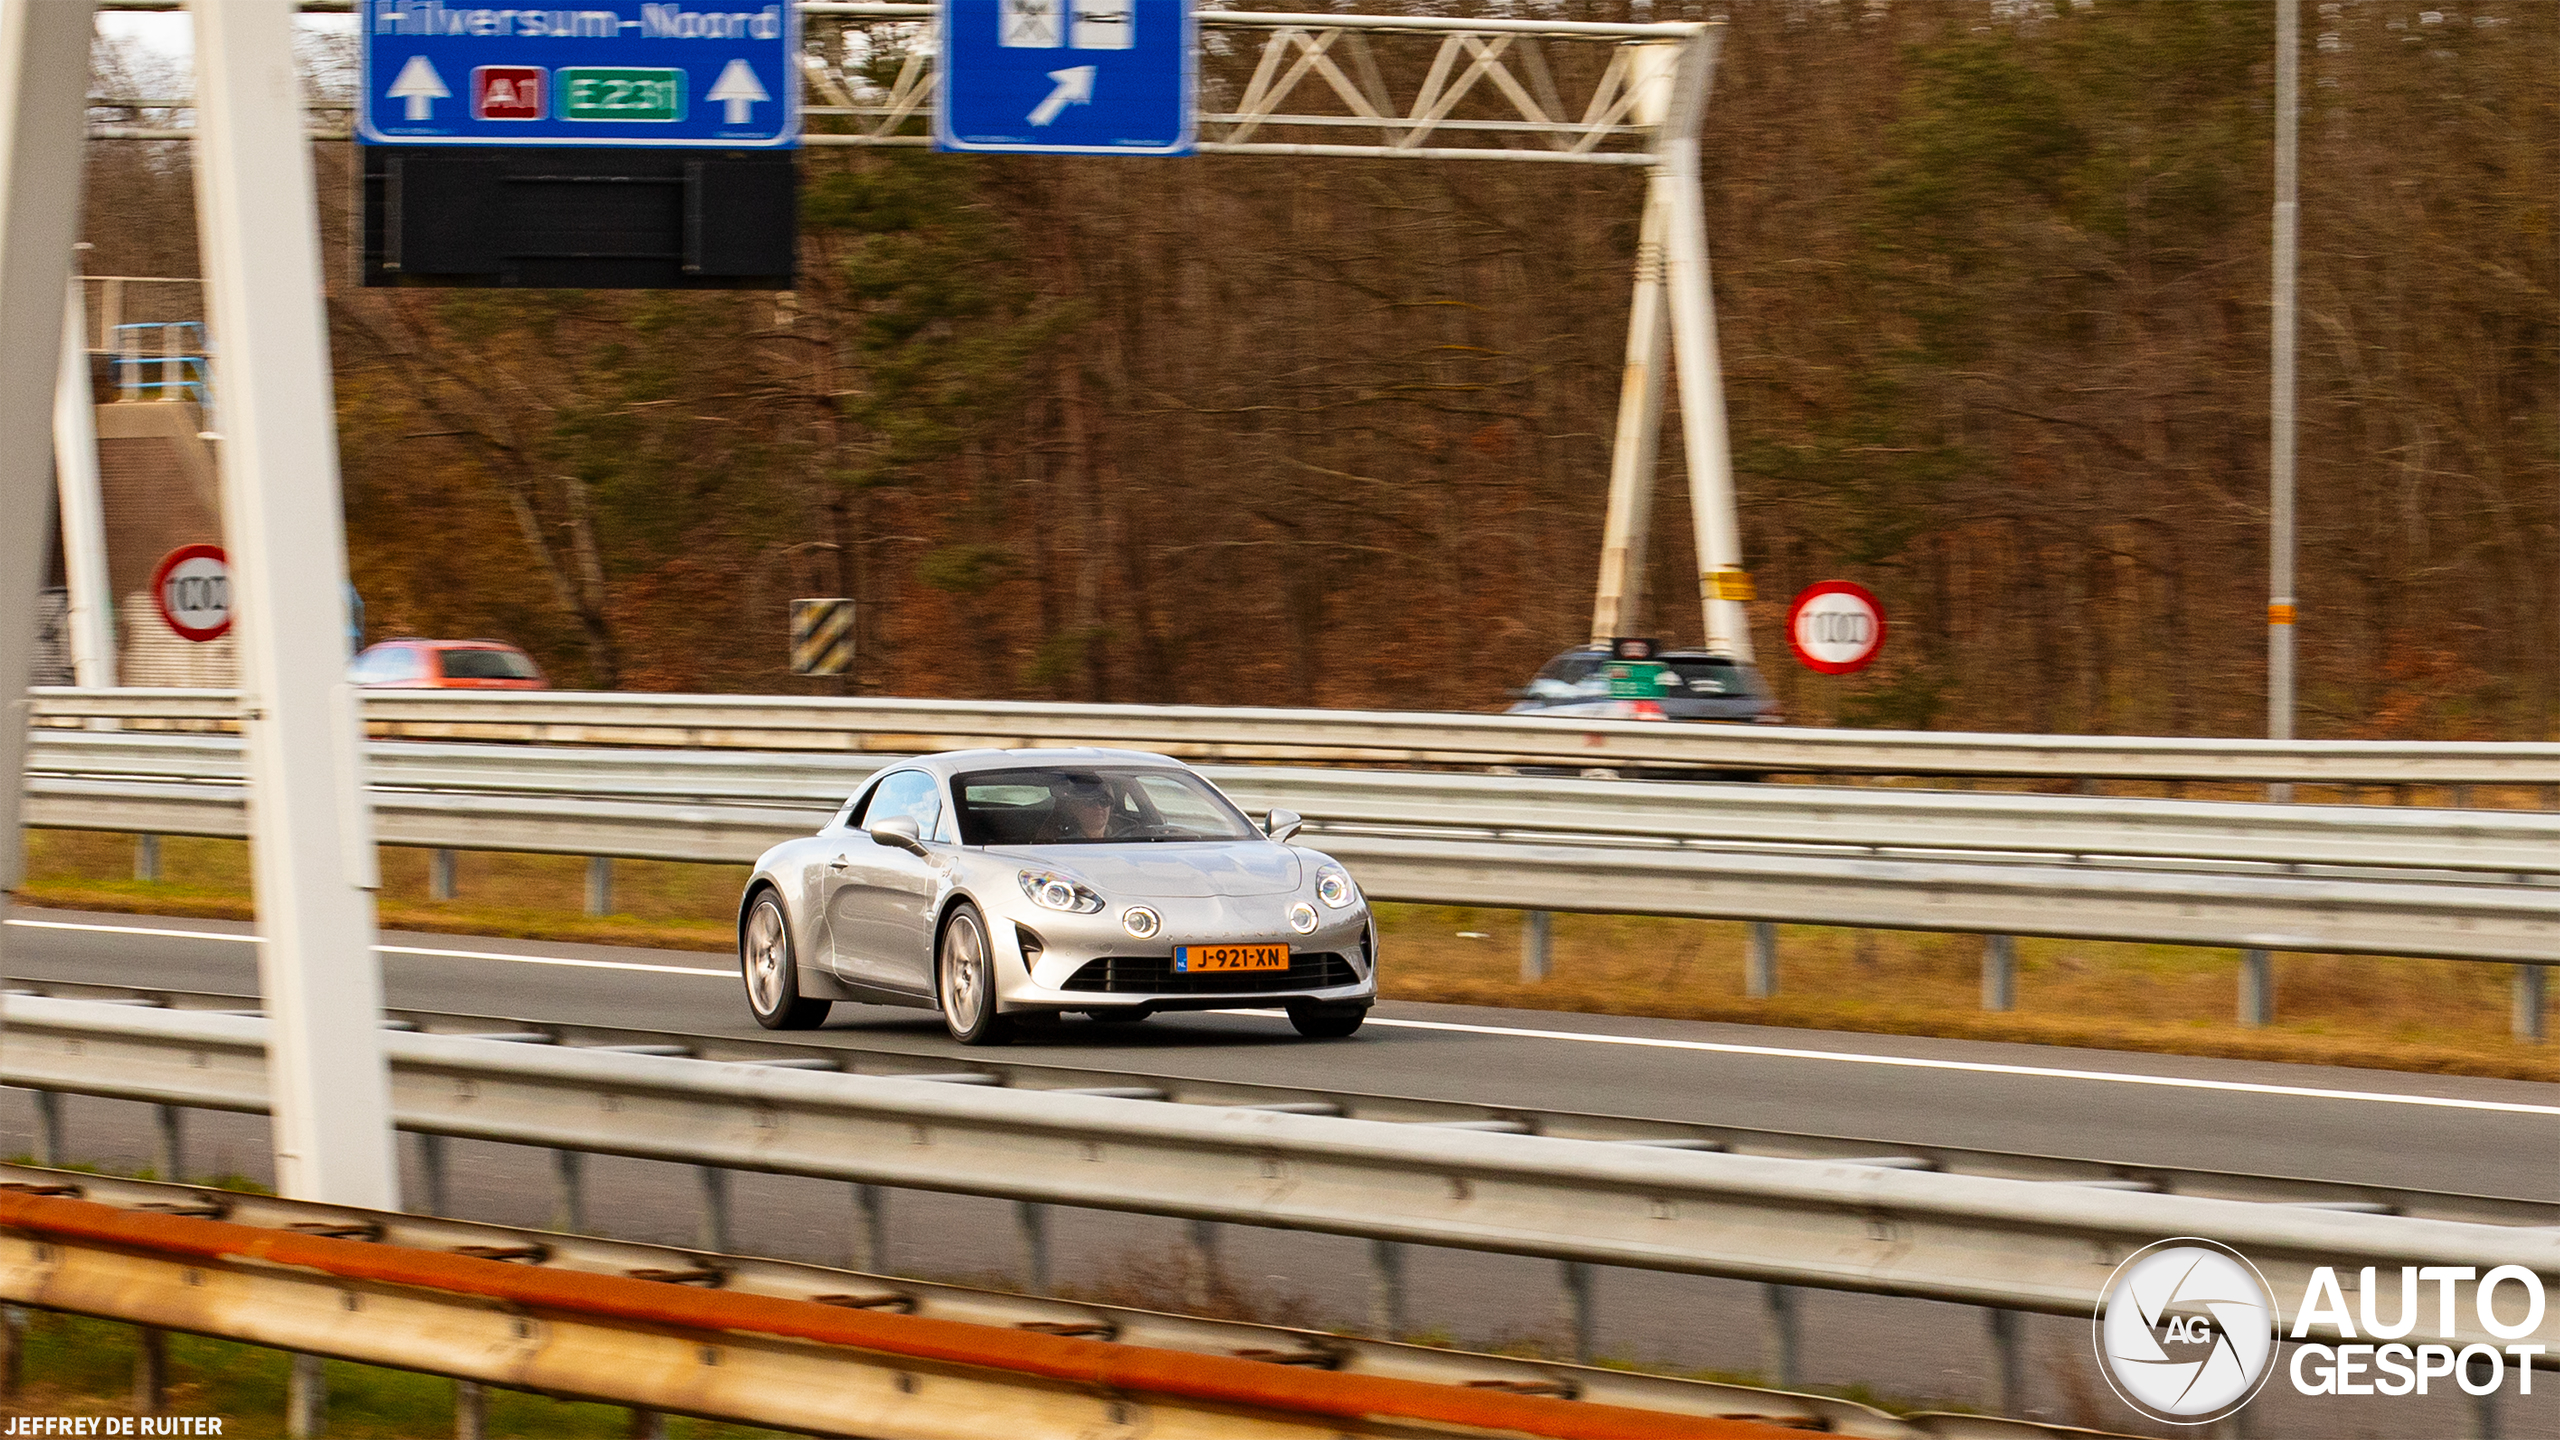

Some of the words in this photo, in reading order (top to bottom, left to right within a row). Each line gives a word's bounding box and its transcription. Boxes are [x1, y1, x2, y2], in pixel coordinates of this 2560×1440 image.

[374, 0, 780, 38] Hilversum-Noord
[482, 78, 539, 109] A1
[569, 79, 678, 109] E231
[1197, 948, 1280, 967] J-921-XN
